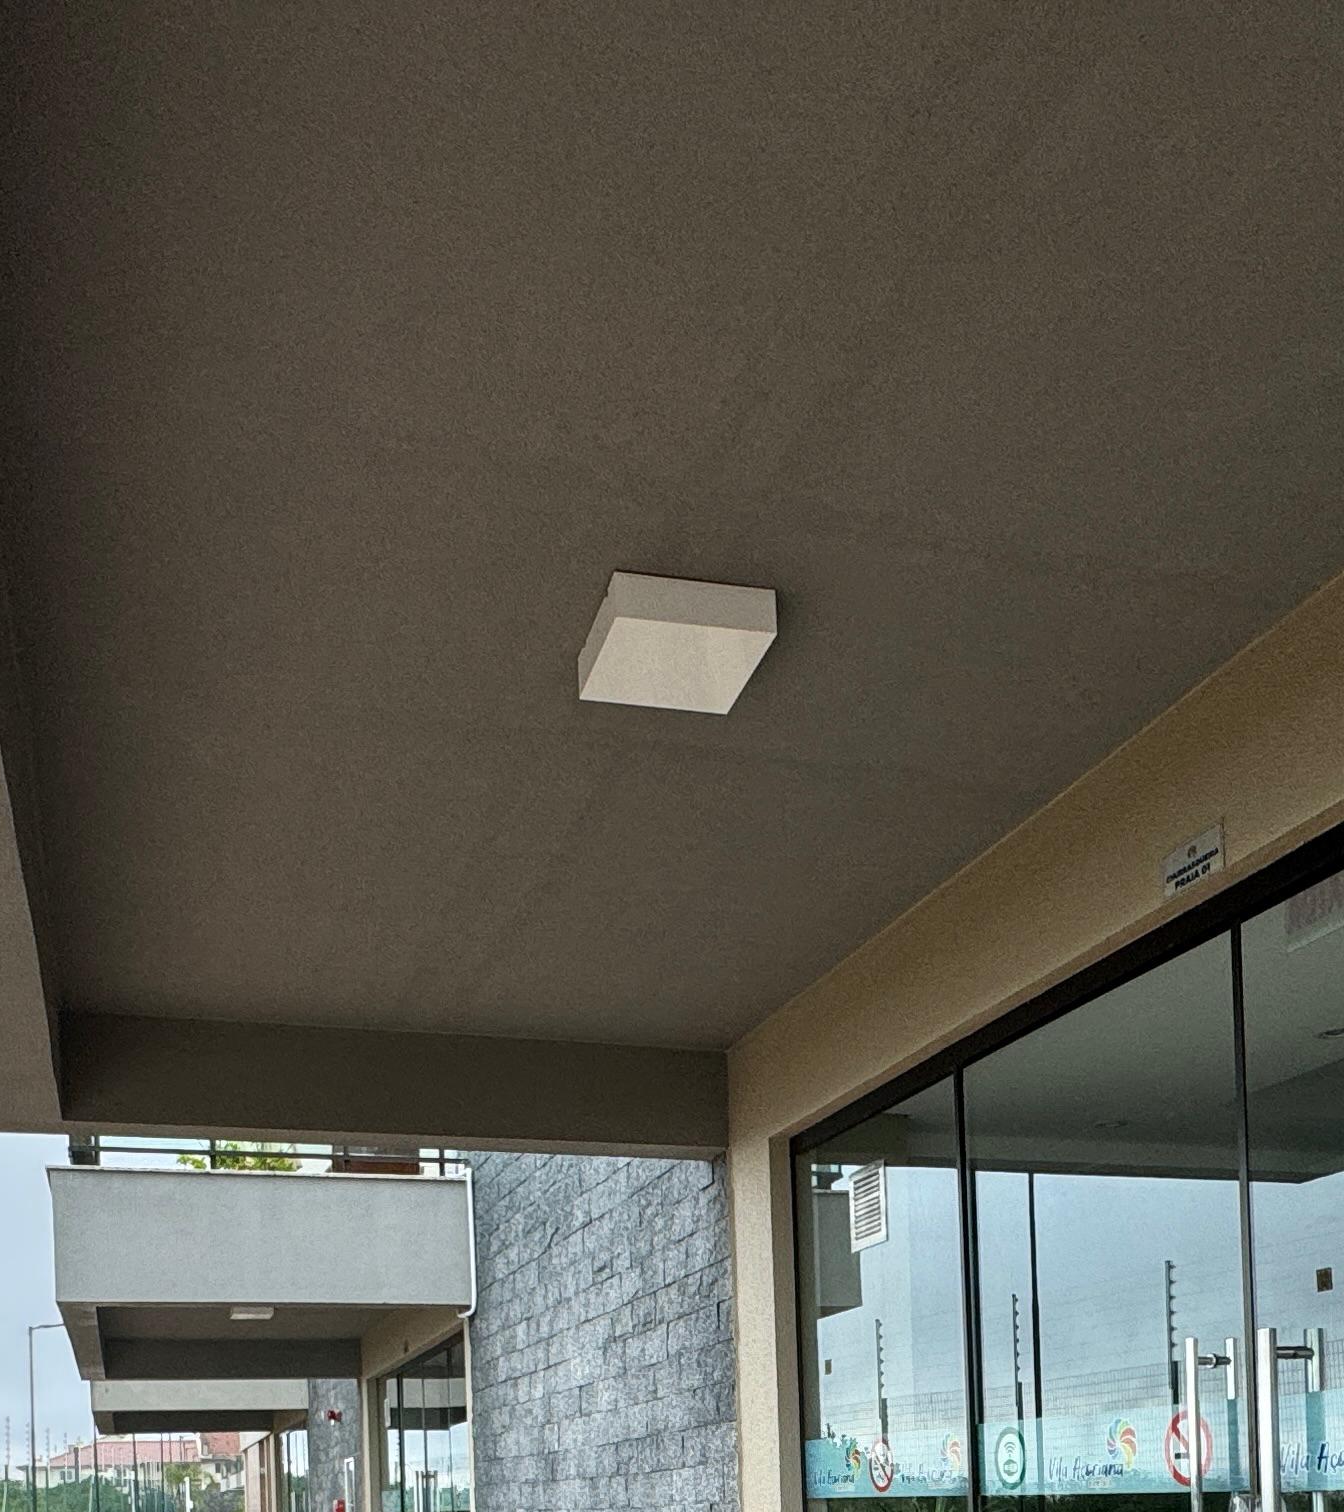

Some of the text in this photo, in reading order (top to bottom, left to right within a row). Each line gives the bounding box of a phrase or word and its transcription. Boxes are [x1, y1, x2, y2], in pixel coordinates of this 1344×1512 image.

[1175, 870, 1200, 890] PRAIA
[1049, 1457, 1068, 1481] Vila
[1279, 1443, 1310, 1475] Vila
